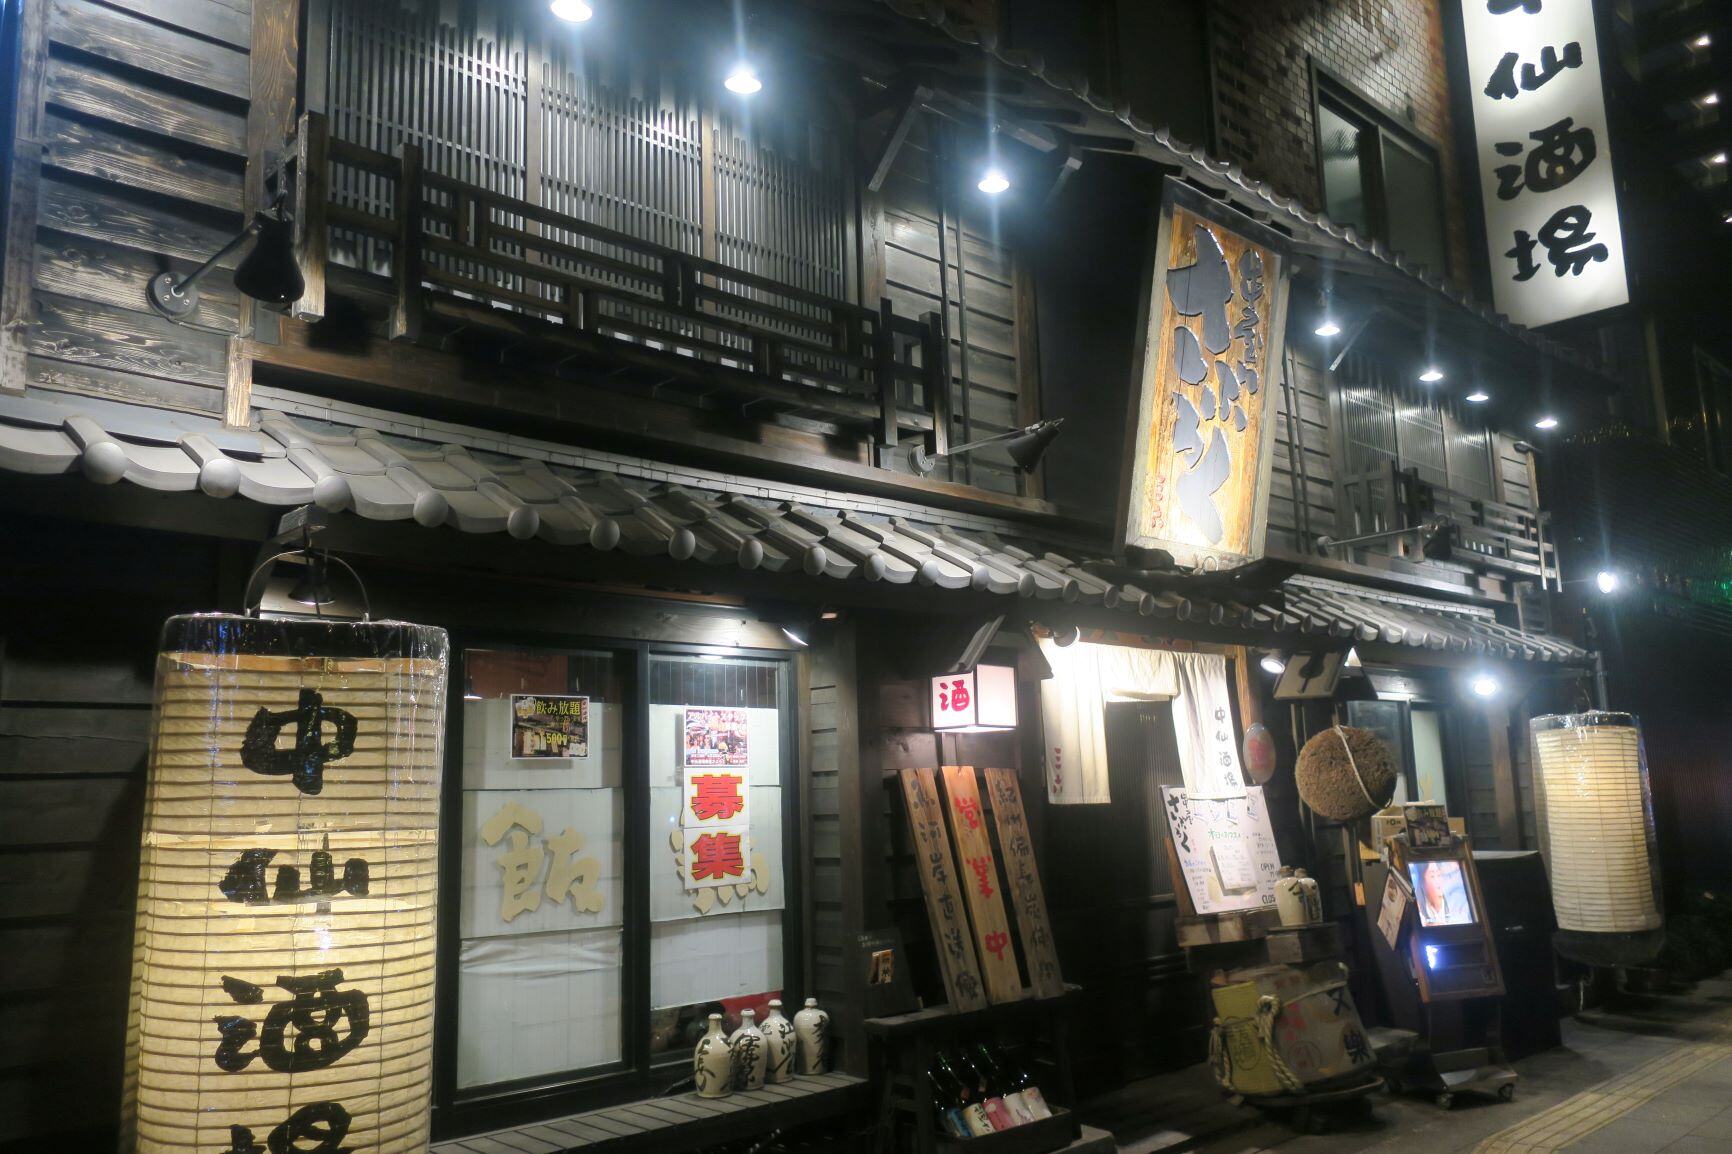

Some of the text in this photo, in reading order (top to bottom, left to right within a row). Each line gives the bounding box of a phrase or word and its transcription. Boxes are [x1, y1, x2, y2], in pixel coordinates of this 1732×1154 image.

[1485, 0, 1608, 282] 仙酒場
[536, 700, 581, 715] 飲み放題
[938, 680, 971, 712] 酒
[1213, 705, 1238, 788] 中仙酒場
[690, 772, 746, 880] 募集
[953, 795, 1008, 962] 営業中
[1261, 895, 1276, 904] CLOS
